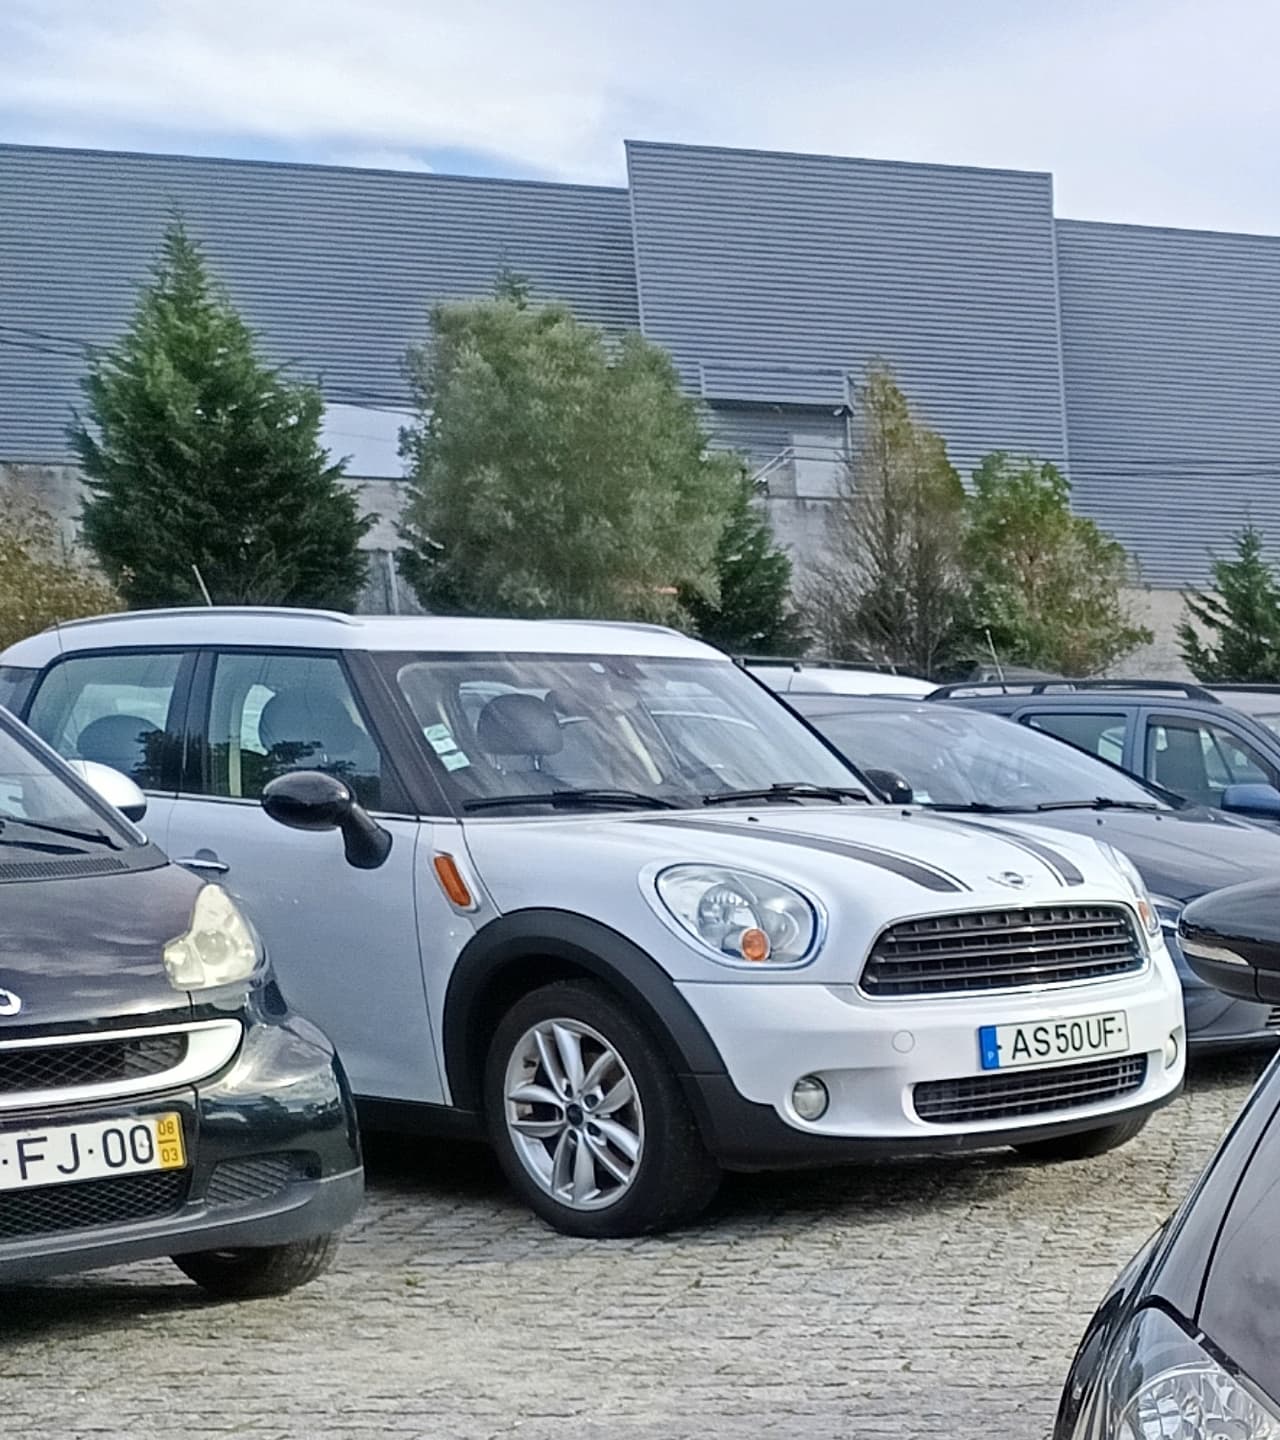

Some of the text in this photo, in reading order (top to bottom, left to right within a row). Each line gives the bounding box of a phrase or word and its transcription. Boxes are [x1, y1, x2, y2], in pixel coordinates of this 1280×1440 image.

[1011, 1016, 1116, 1061] AS50UF
[158, 1121, 175, 1135] 08
[161, 1148, 179, 1162] 03
